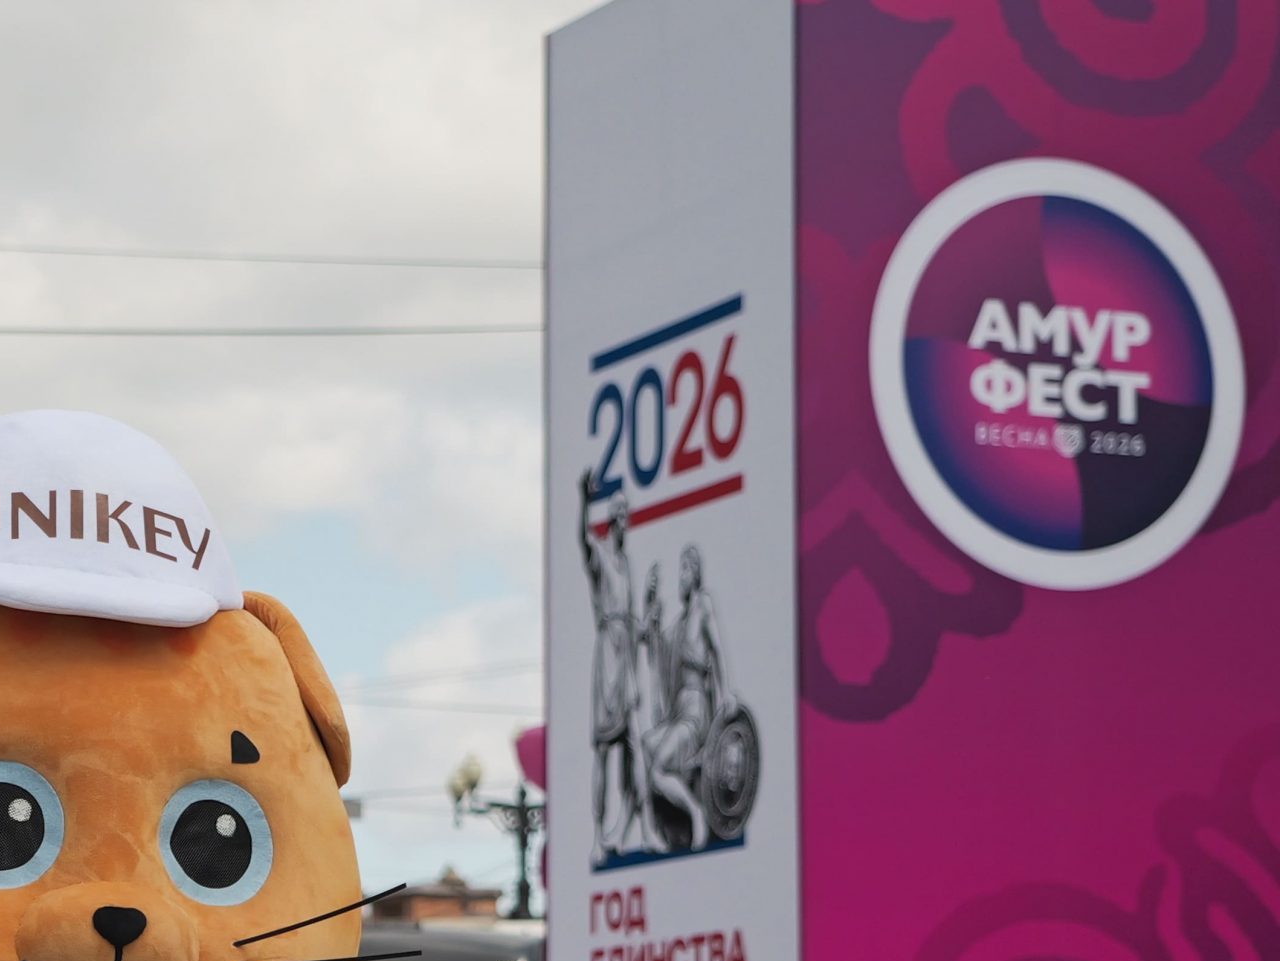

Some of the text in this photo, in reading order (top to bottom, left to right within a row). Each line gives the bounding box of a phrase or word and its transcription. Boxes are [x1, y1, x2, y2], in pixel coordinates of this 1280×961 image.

[967, 298, 1152, 367] АМУР
[586, 332, 744, 503] 2026
[970, 358, 1151, 425] ФЕСТ
[1089, 430, 1147, 457] 2026
[590, 886, 646, 934] ГОД
